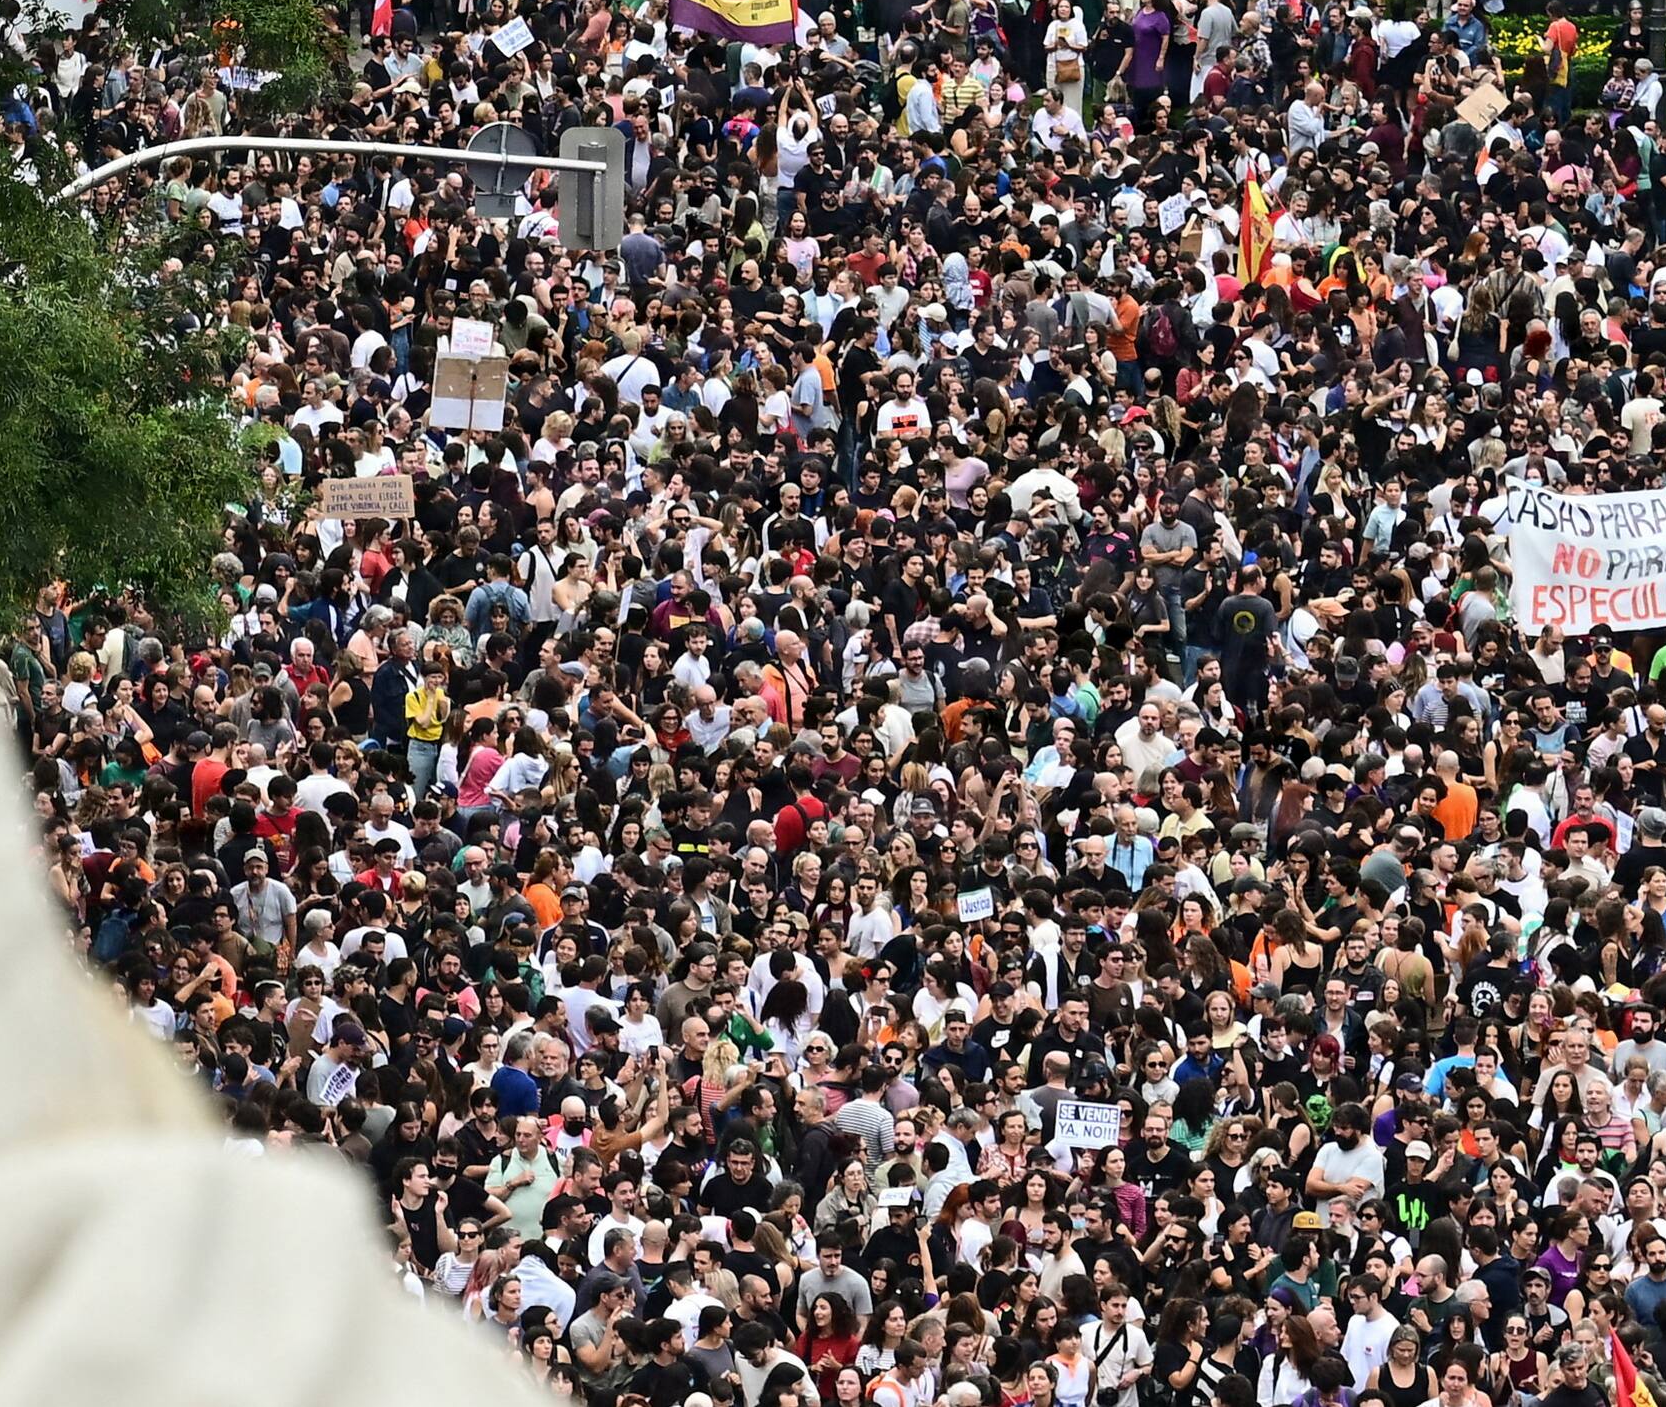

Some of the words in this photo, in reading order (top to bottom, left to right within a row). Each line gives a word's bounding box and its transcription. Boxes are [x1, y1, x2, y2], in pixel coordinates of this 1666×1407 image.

[330, 483, 344, 492] QUE
[331, 494, 353, 503] TENGA
[358, 492, 372, 501] QUE
[326, 503, 347, 513] ENTRE
[389, 501, 410, 510] CALLE
[1552, 542, 1602, 580] NO
[1059, 1105, 1076, 1120] SE
[1078, 1106, 1119, 1124] VENDE
